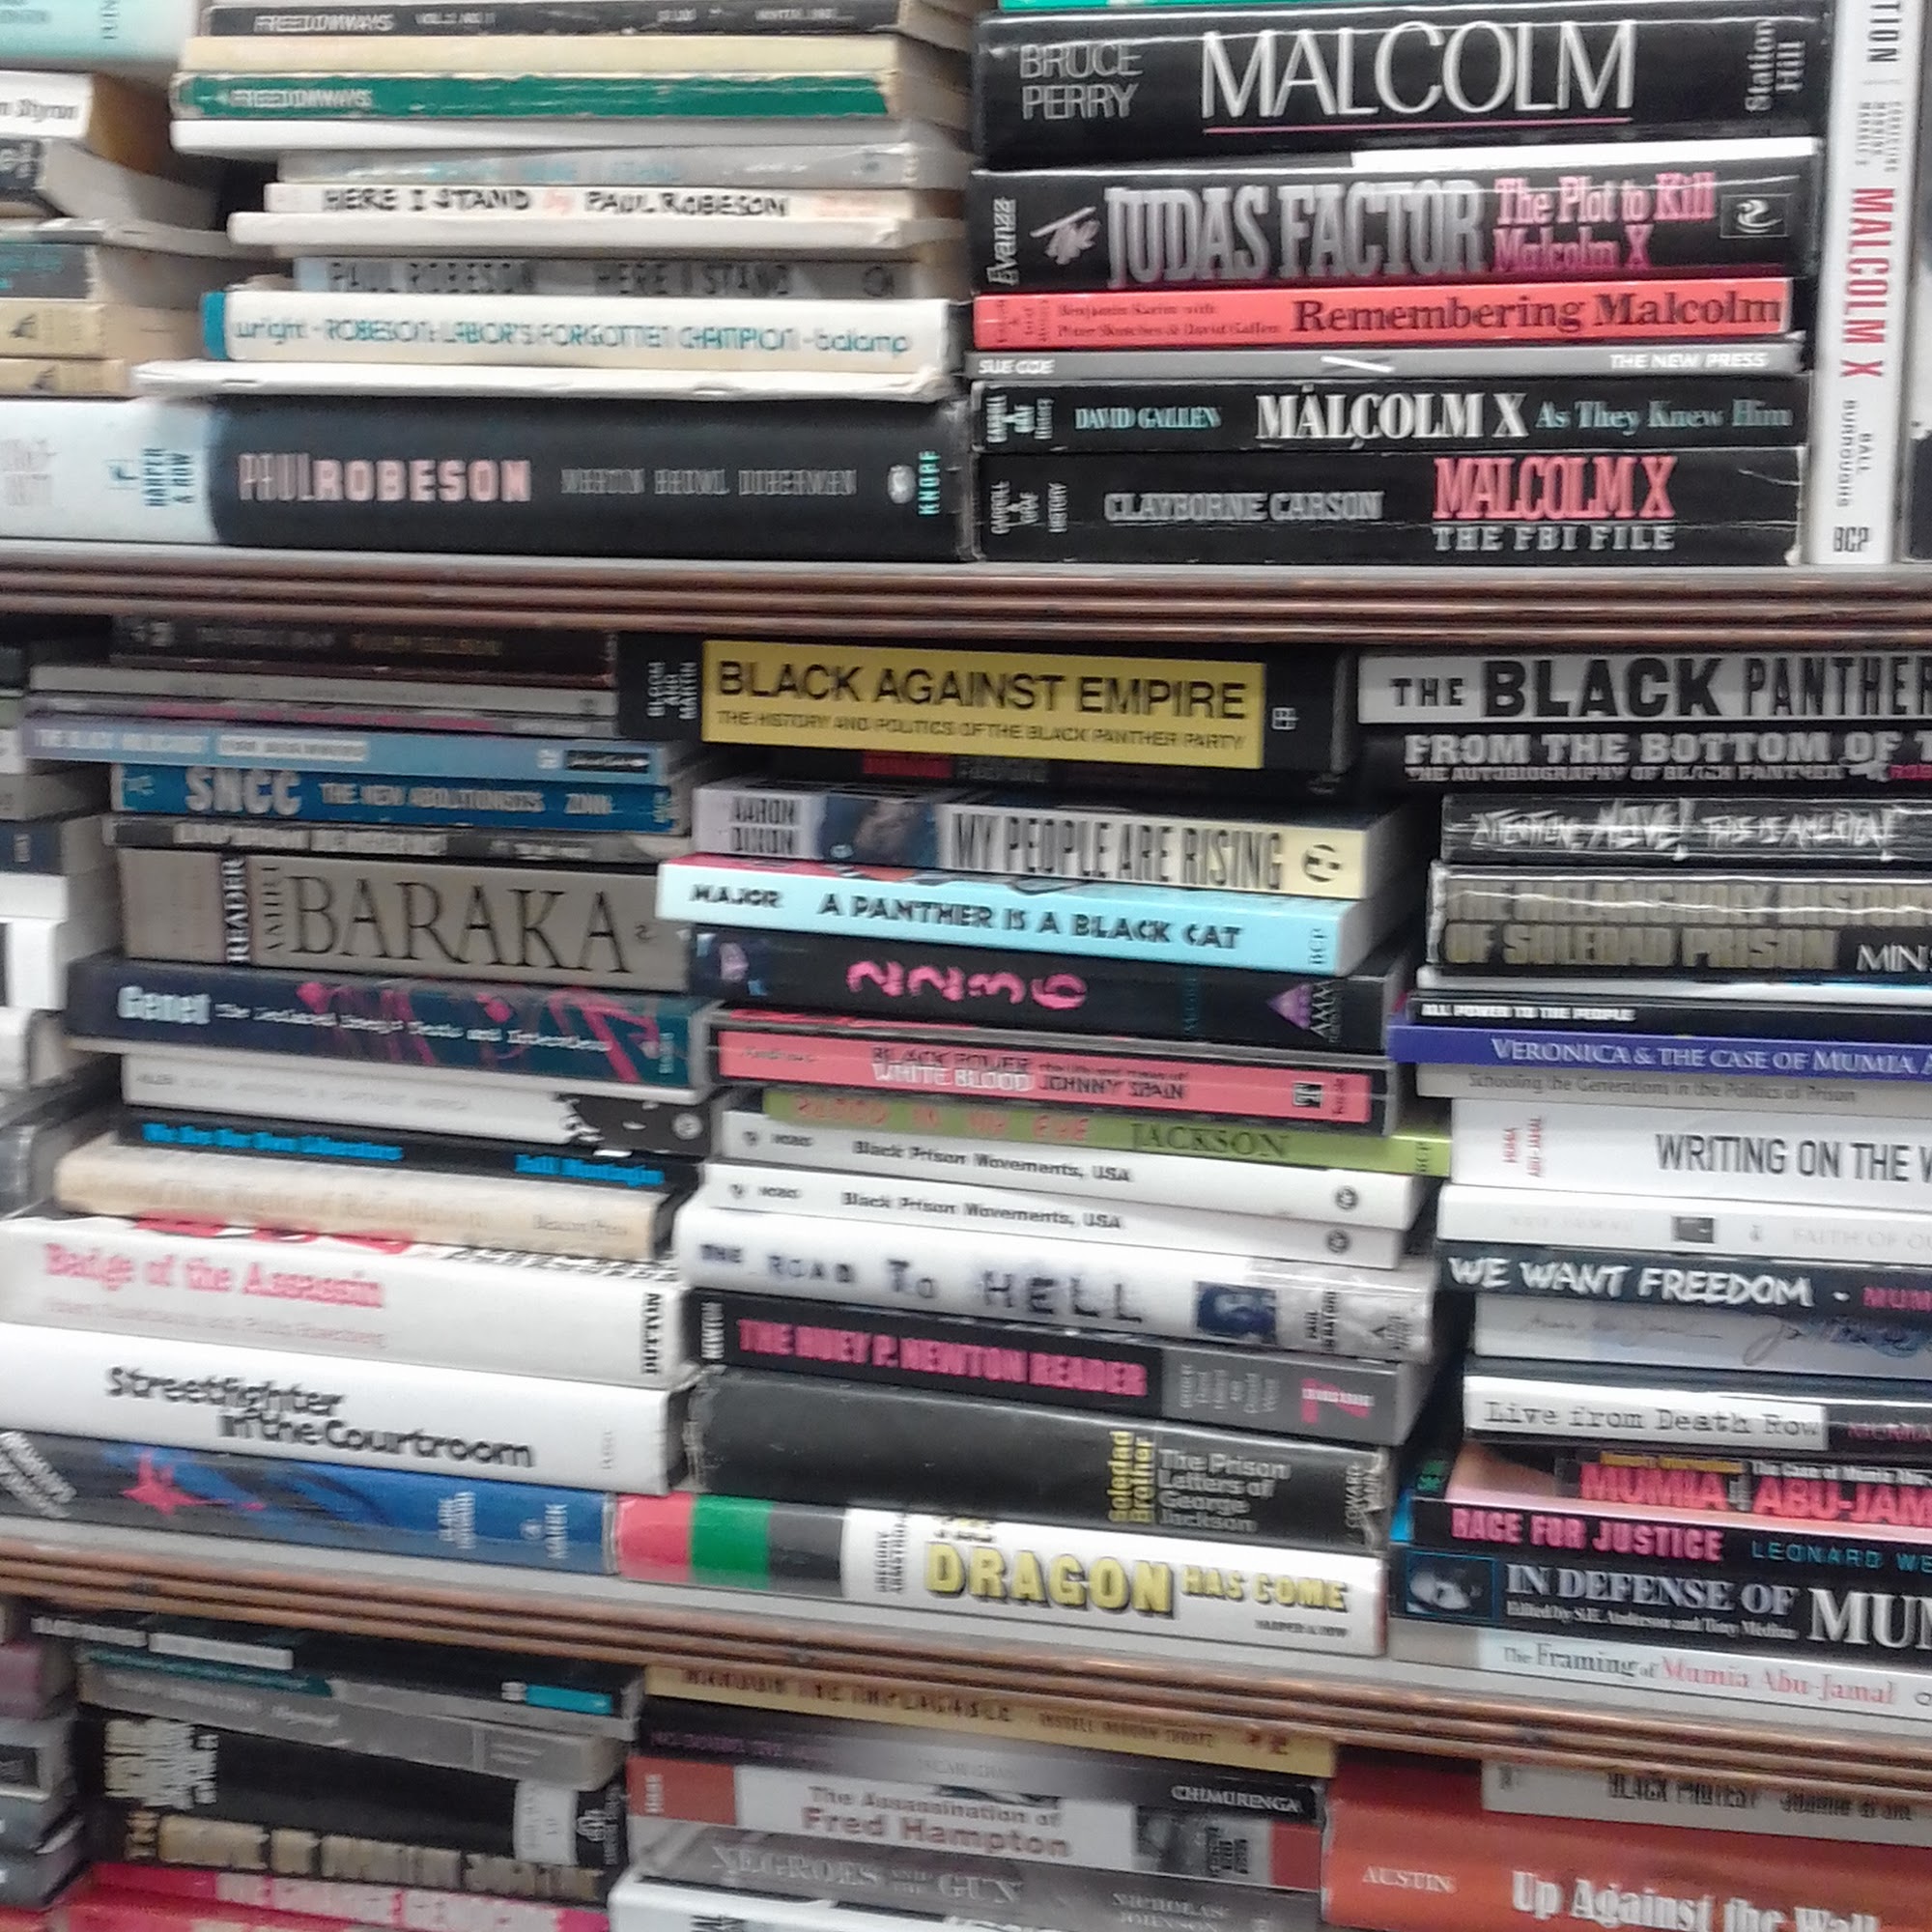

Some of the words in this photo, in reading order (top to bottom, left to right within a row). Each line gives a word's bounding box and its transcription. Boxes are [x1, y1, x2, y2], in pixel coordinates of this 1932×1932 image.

[1020, 44, 1143, 79] BRUCE
[1201, 20, 1637, 119] MALCOLM
[1745, 20, 1776, 113] Station
[1776, 40, 1806, 93] Hill
[1021, 83, 1141, 121] PERRY
[324, 190, 397, 212] HERE
[435, 189, 529, 211] STAND
[583, 191, 656, 213] PAUL
[661, 193, 789, 217] ROBESON
[1493, 177, 1553, 225] The
[1556, 175, 1617, 223] Plot
[1621, 178, 1655, 222] to
[1655, 172, 1716, 222] Kill
[1103, 185, 1270, 288] JUDAS
[1278, 179, 1490, 280] FACTOR
[1624, 224, 1655, 270] X
[1841, 187, 1895, 345] MALCOLM
[1293, 295, 1585, 334] Remembering
[1593, 291, 1782, 326] Malcolm
[979, 359, 1013, 375] SUE
[1016, 359, 1055, 375] COE
[1610, 353, 1650, 370] THE
[1652, 352, 1700, 369] NEW
[1705, 352, 1770, 369] PRESS
[1840, 359, 1885, 378] X
[1074, 407, 1135, 430] DAVID
[1138, 406, 1223, 430] GALLEN
[1256, 388, 1486, 447] MALCOLM
[1492, 393, 1529, 438] X
[1535, 400, 1571, 429] As
[1575, 400, 1639, 437] They
[1647, 400, 1722, 429] Knew
[1732, 399, 1793, 428] Him
[238, 453, 314, 502] PAUL
[314, 458, 531, 502] ROBESON
[1836, 399, 1857, 508] BURROUGHS
[1857, 432, 1874, 475] BALL
[1103, 492, 1268, 522] CLAYBORNE
[1269, 491, 1385, 521] CARSON
[1433, 456, 1638, 521] MALCOLM
[1642, 455, 1679, 519] X
[1432, 526, 1504, 553] THE
[1514, 526, 1577, 552] FBI
[1589, 526, 1676, 551] FILE
[720, 660, 863, 702] BLACK
[874, 668, 1065, 712] AGAINST
[1077, 675, 1246, 720] EMPIRE
[1389, 677, 1464, 708] THE
[1480, 657, 1725, 718] BLACK
[717, 710, 753, 725] THE
[753, 712, 831, 729] HISTORY
[878, 717, 954, 736] POLITICS
[1029, 724, 1087, 743] BLACK
[1092, 729, 1179, 748] PANTHER
[1185, 733, 1247, 752] PARTY
[1405, 733, 1531, 765] FROM
[1541, 733, 1630, 764] THE
[1640, 732, 1833, 763] BOTTOM
[1843, 730, 1903, 762] OF
[185, 768, 301, 816] SNCC
[952, 811, 996, 871] MY
[1006, 816, 1111, 877] PEOPLE
[1120, 824, 1174, 881] ARE
[1181, 828, 1282, 890] RISING
[221, 856, 251, 964] READER
[284, 874, 632, 974] BARAKA
[689, 884, 783, 908] MAJOR
[818, 895, 843, 916] A
[850, 896, 992, 929] PANTHER
[1003, 908, 1025, 930] IS
[1037, 912, 1061, 934] A
[1071, 914, 1171, 944] BLACK
[1181, 924, 1242, 950] CAT
[1446, 923, 1494, 964] OF
[1681, 926, 1837, 971] PRISON
[1454, 1005, 1511, 1019] POWER
[1572, 1008, 1636, 1023] PEOPLE
[1491, 1037, 1630, 1065] VERONICA
[1633, 1044, 1659, 1065] &
[1661, 1045, 1703, 1066] THE
[1709, 1048, 1770, 1070] CASE
[1772, 1051, 1808, 1071] OF
[1813, 1050, 1918, 1074] MUMIA
[870, 1064, 953, 1086] WHITE
[953, 1070, 1034, 1092] BLOOD
[1038, 1075, 1123, 1094] JOHNNY
[1127, 1081, 1185, 1099] SPAIN
[852, 1141, 904, 1159] Black
[909, 1146, 966, 1164] Prison
[973, 1152, 1084, 1179] Movements,
[1092, 1165, 1132, 1183] USA
[1130, 1122, 1291, 1159] JACKSON
[1655, 1133, 1787, 1176] WRITING
[1795, 1139, 1842, 1179] ON
[1849, 1141, 1909, 1182] THE
[841, 1192, 889, 1210] Black
[897, 1197, 955, 1215] Prison
[963, 1203, 1074, 1227] Movements,
[1082, 1214, 1122, 1231] USA
[185, 1257, 233, 1293] the
[242, 1262, 384, 1309] Assassin
[769, 1255, 857, 1283] ROAD
[981, 1269, 1143, 1323] HELL
[1448, 1256, 1512, 1288] WE
[1520, 1260, 1634, 1298] WANT
[1635, 1265, 1814, 1308] FREEDOM
[639, 1293, 664, 1375] DUTTON
[738, 1319, 794, 1355] THE
[899, 1338, 1028, 1382] NEWTON
[1029, 1351, 1148, 1397] READER
[105, 1365, 346, 1415] Streetfighter
[1485, 1400, 1557, 1429] Live
[1568, 1404, 1646, 1431] from
[1658, 1408, 1751, 1435] Death
[1762, 1414, 1820, 1436] Row
[325, 1419, 535, 1468] Courtroom
[1159, 1450, 1206, 1471] The
[1208, 1452, 1291, 1480] Prison
[1108, 1431, 1133, 1522] Soledad
[1132, 1436, 1155, 1522] Brother
[1158, 1469, 1245, 1495] Letters
[1247, 1478, 1277, 1498] of
[1580, 1463, 1729, 1511] MUMIA
[1158, 1491, 1250, 1515] George
[1158, 1509, 1258, 1532] Jackson
[1452, 1507, 1522, 1543] RACE
[1530, 1515, 1587, 1548] FOR
[1592, 1520, 1724, 1562] JUSTICE
[1752, 1540, 1883, 1569] LEONARD
[924, 1541, 1176, 1619] DRAGON
[1181, 1565, 1245, 1602] HAS
[1253, 1573, 1348, 1612] COME
[1506, 1563, 1551, 1597] IN
[1556, 1568, 1735, 1610] DEFENSE
[1742, 1583, 1801, 1615] OF
[1503, 1646, 1532, 1665] The
[1535, 1643, 1638, 1679] Framing
[1662, 1657, 1750, 1690] Mumia
[1764, 1668, 1896, 1704] Abu-Jamal
[808, 1786, 853, 1806] The
[861, 1790, 1026, 1824] Assassination
[1171, 1785, 1301, 1813] CHIMURENGA
[802, 1806, 887, 1836] Fred
[899, 1816, 1071, 1861] Hampton
[1363, 1864, 1457, 1893] AUSTIN
[1512, 1870, 1563, 1919] Up
[1571, 1879, 1716, 1932] Against
